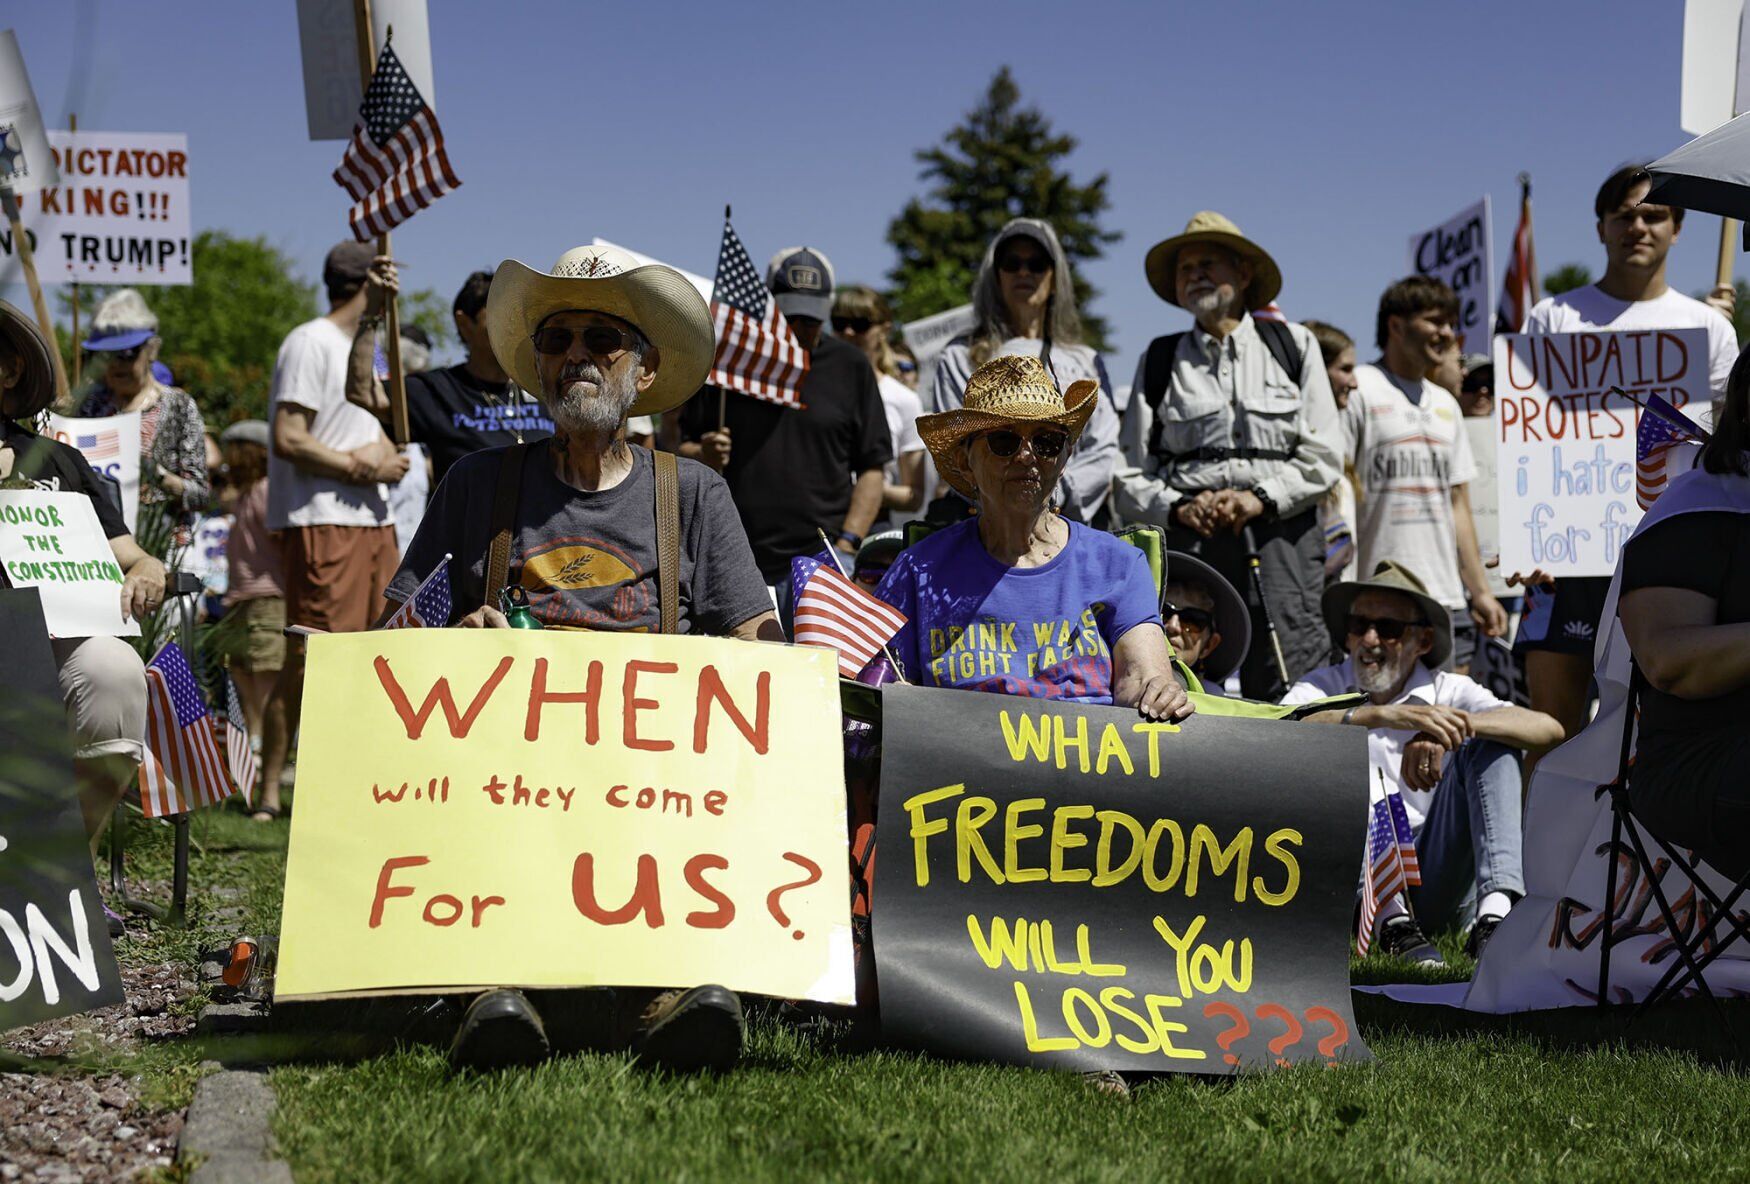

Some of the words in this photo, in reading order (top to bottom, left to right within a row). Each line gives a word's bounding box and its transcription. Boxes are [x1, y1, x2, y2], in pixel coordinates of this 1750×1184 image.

[41, 187, 169, 220] KING!!!
[60, 233, 188, 266] TRUMP!
[1416, 216, 1483, 274] Clean
[1507, 332, 1689, 391] UNPAID
[1516, 455, 1530, 497] i
[1552, 443, 1634, 497] hate
[22, 534, 64, 555] THE
[1522, 502, 1592, 564] for
[7, 559, 125, 585] CONSTITUTION
[930, 622, 1018, 657] DRINK
[931, 651, 1013, 687] FIGHT
[373, 655, 772, 755] WHEN
[999, 710, 1182, 778] WHAT
[372, 777, 451, 805] will
[482, 774, 577, 812] they
[605, 784, 729, 818] come
[903, 783, 1304, 906] FREEDOMS
[369, 856, 506, 929] For
[966, 913, 1128, 977] WILL
